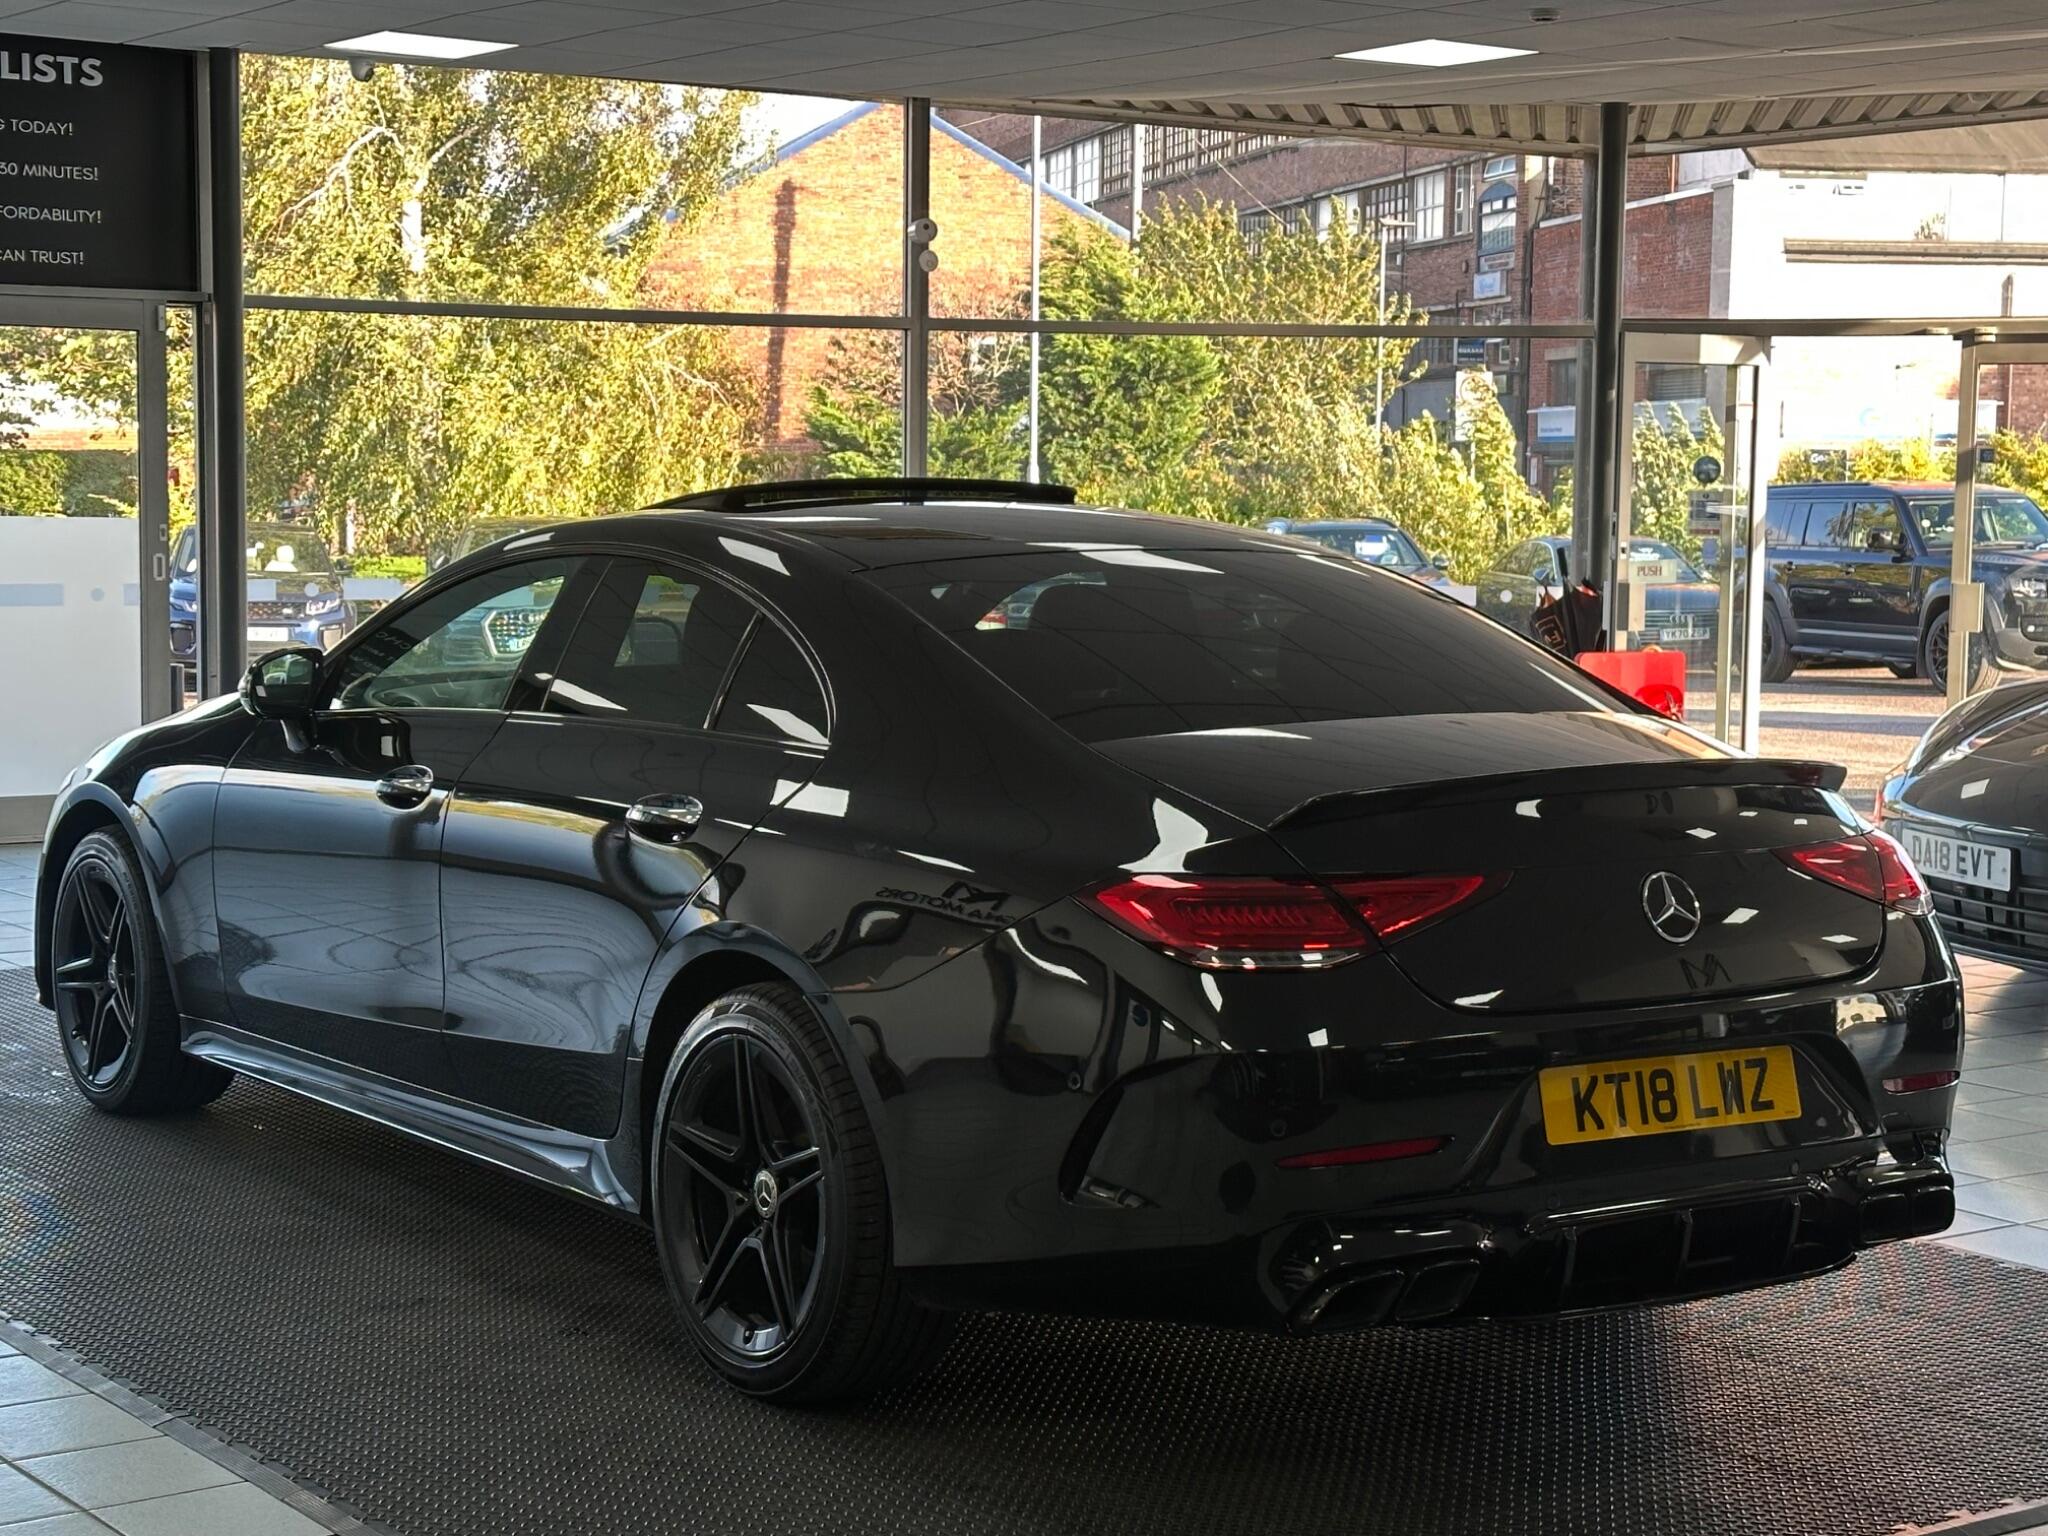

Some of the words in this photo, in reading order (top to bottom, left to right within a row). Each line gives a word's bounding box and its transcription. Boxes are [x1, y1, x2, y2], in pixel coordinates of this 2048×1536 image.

[0, 51, 104, 87] LISTS
[10, 119, 73, 136] TODAY!
[0, 162, 18, 175] 30
[23, 163, 99, 181] MINUTES!
[0, 248, 25, 262] AN
[30, 250, 84, 265] TRUST!
[1636, 566, 1663, 578] PUSH
[1911, 835, 1950, 871] DA18
[1956, 844, 1996, 880] EVT
[1571, 1068, 1678, 1133] KT18
[1688, 1057, 1775, 1120] LWZ
